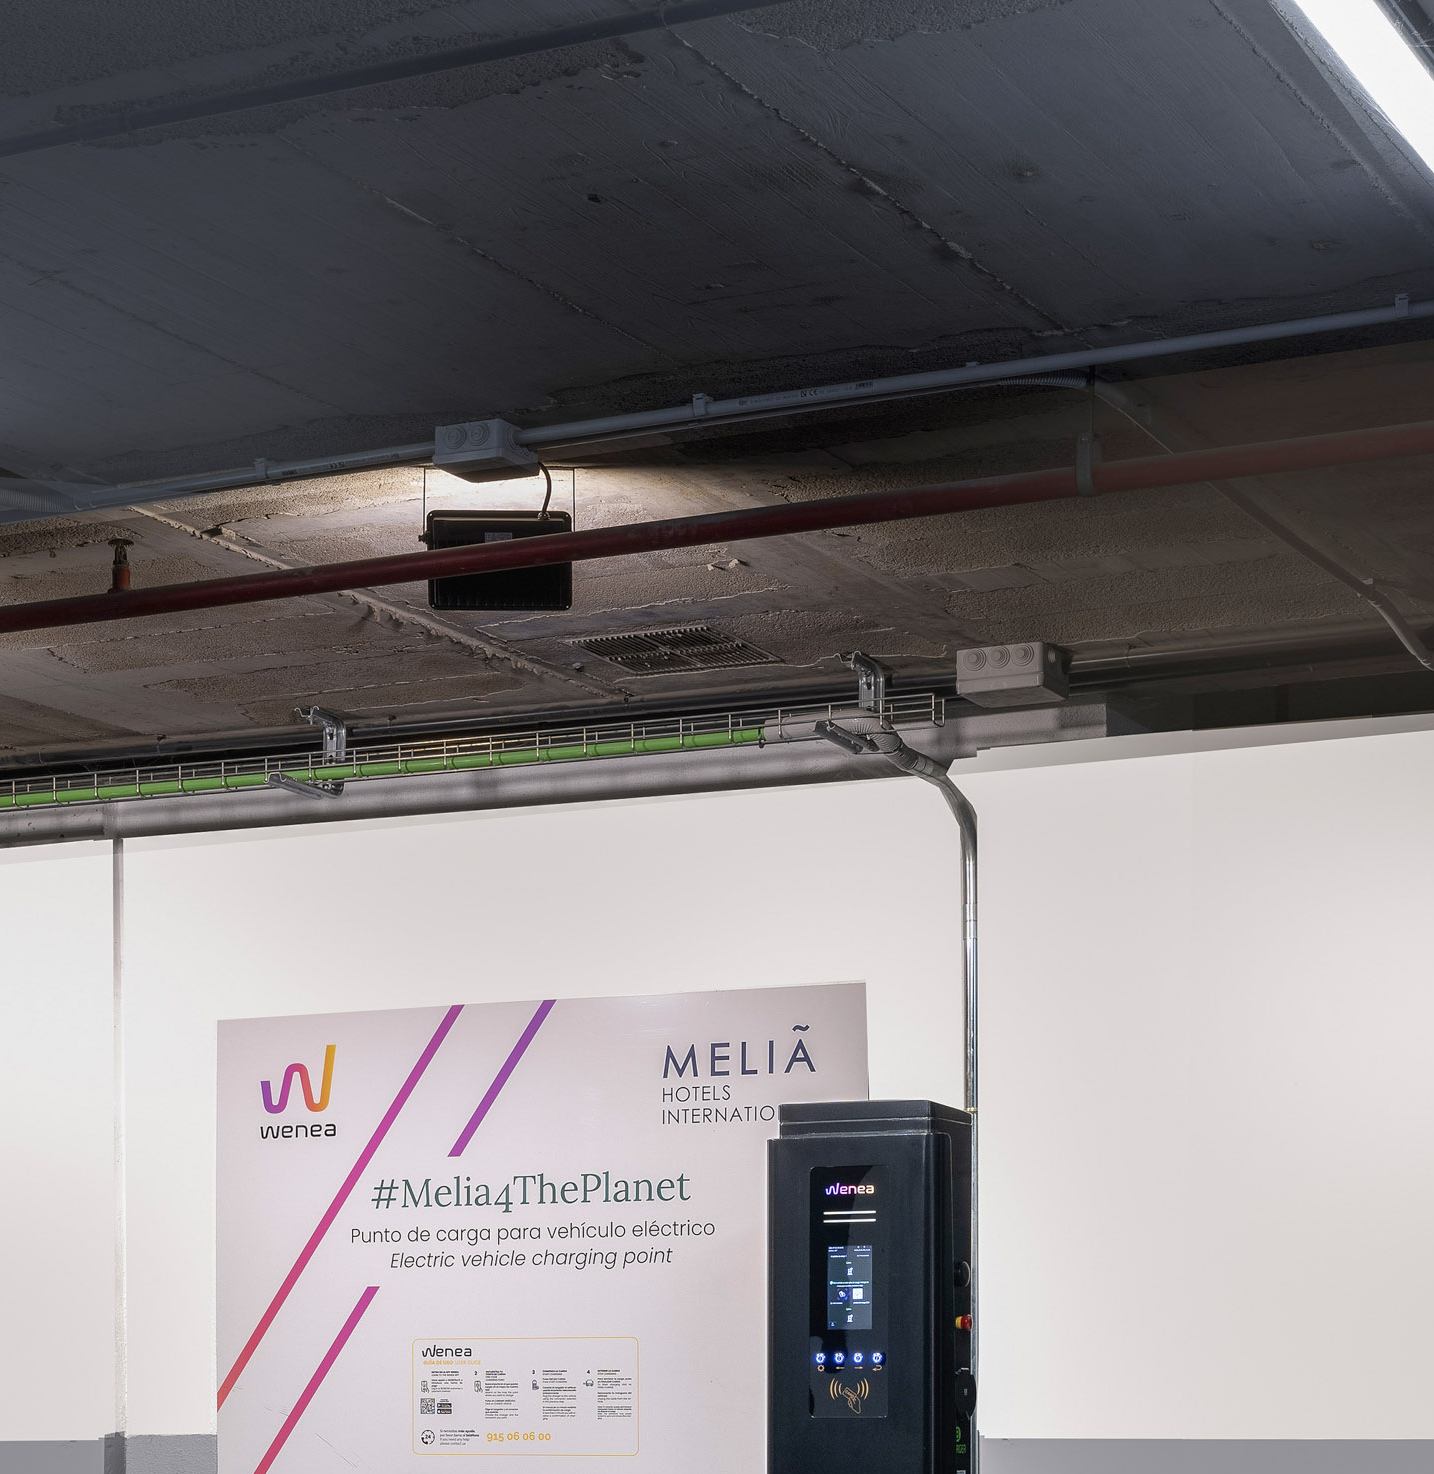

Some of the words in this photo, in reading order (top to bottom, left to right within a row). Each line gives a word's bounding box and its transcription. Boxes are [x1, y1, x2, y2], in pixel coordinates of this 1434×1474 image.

[662, 1024, 816, 1078] MELIÃ
[662, 1084, 731, 1102] HOTELS
[662, 1105, 780, 1124] INTERNATIO
[259, 1123, 337, 1140] wenea
[371, 1171, 692, 1214] #Melia4ThePlanet
[351, 1227, 402, 1243] Punto
[408, 1226, 431, 1242] de
[436, 1229, 491, 1246] carga
[497, 1227, 541, 1244] para
[546, 1221, 626, 1239] vehículo
[631, 1219, 716, 1238] eléctrico
[390, 1251, 456, 1269] Electric
[461, 1249, 526, 1267] vehicle
[531, 1248, 618, 1271] charging
[622, 1247, 674, 1270] point
[487, 1433, 505, 1442] 915
[507, 1432, 520, 1441] 06
[522, 1432, 536, 1441] 06
[538, 1432, 551, 1441] 00
